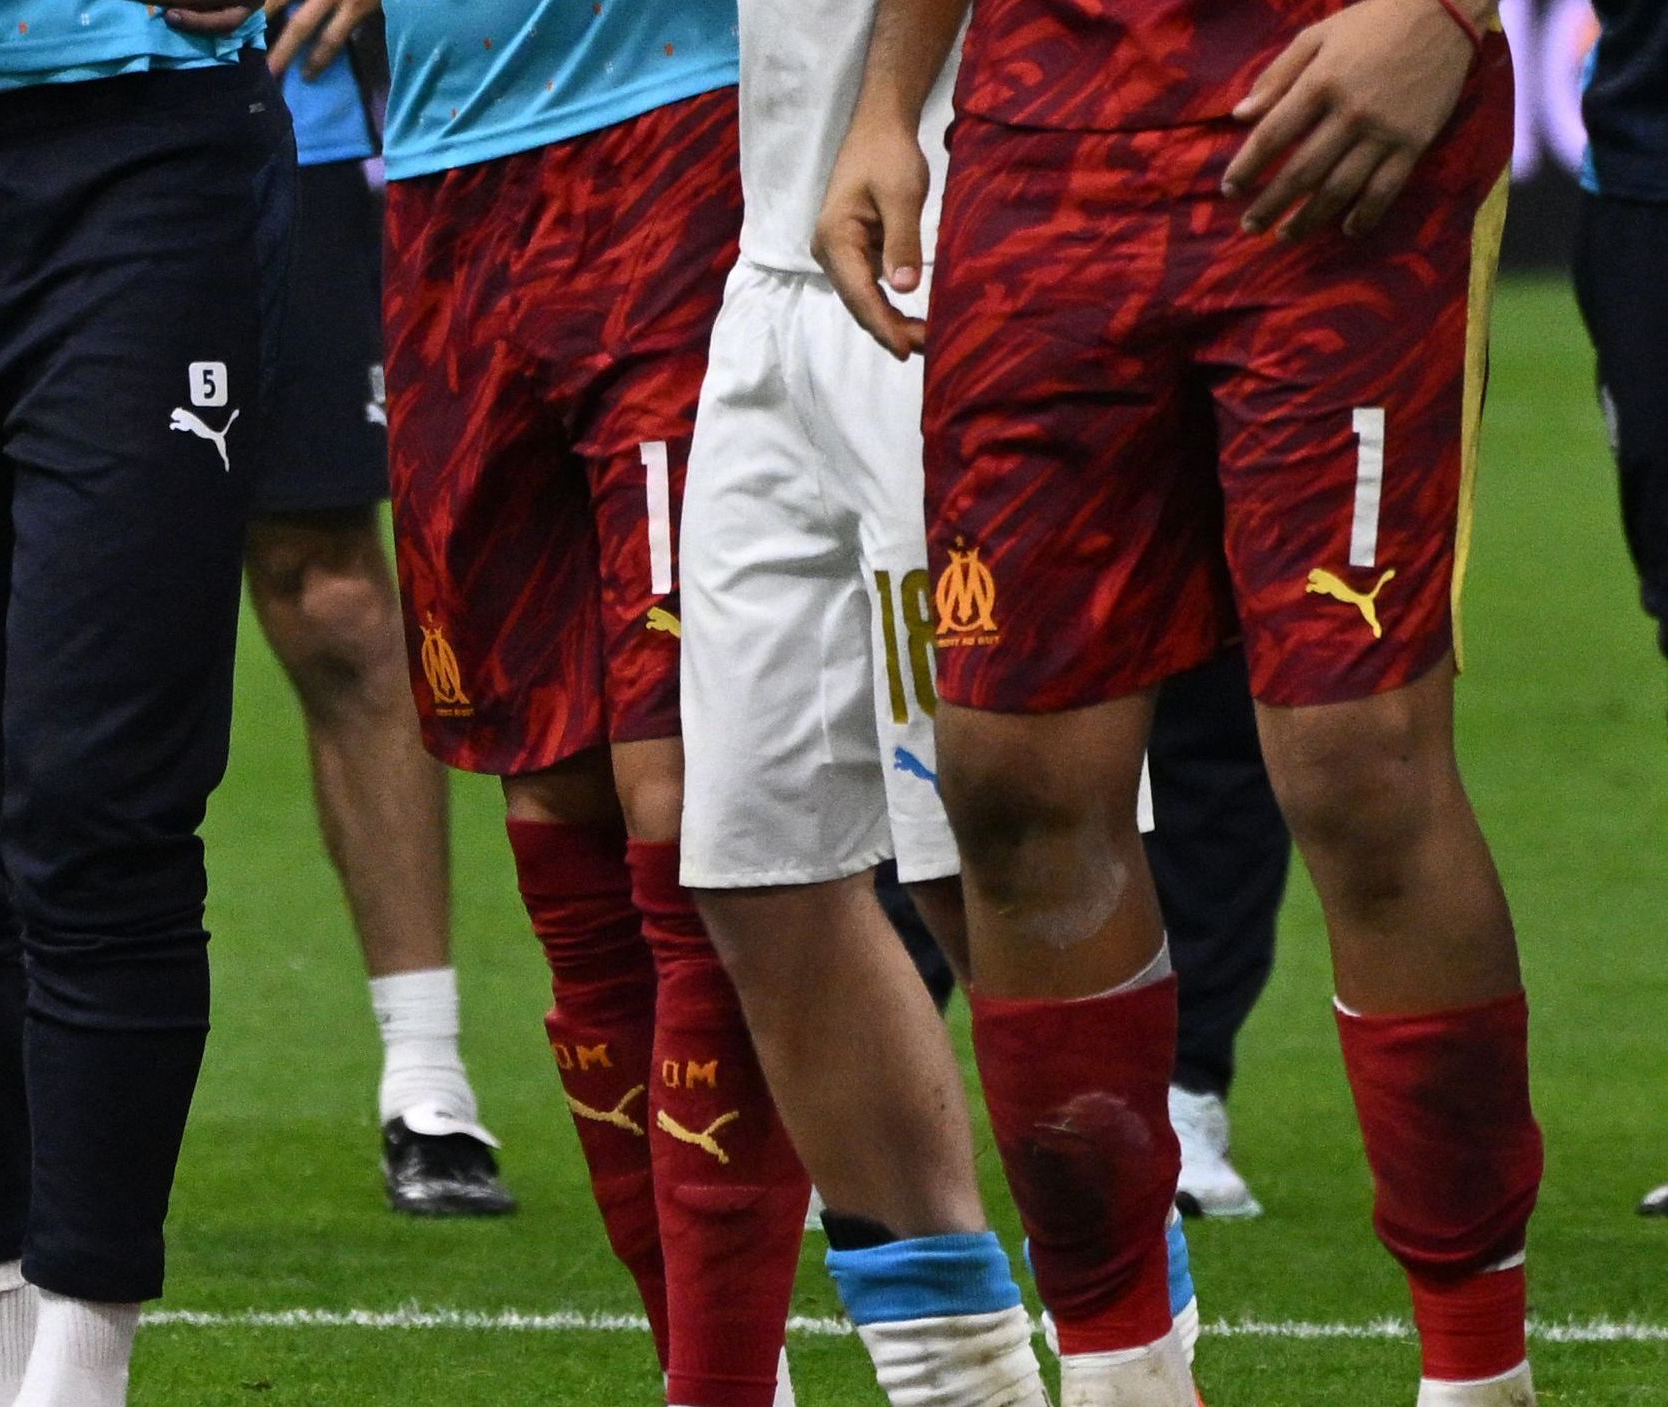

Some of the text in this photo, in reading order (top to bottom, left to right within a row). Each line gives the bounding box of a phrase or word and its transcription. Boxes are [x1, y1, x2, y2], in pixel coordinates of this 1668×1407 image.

[202, 369, 216, 399] 5
[1349, 408, 1385, 568] 1
[662, 1059, 718, 1089] OM
